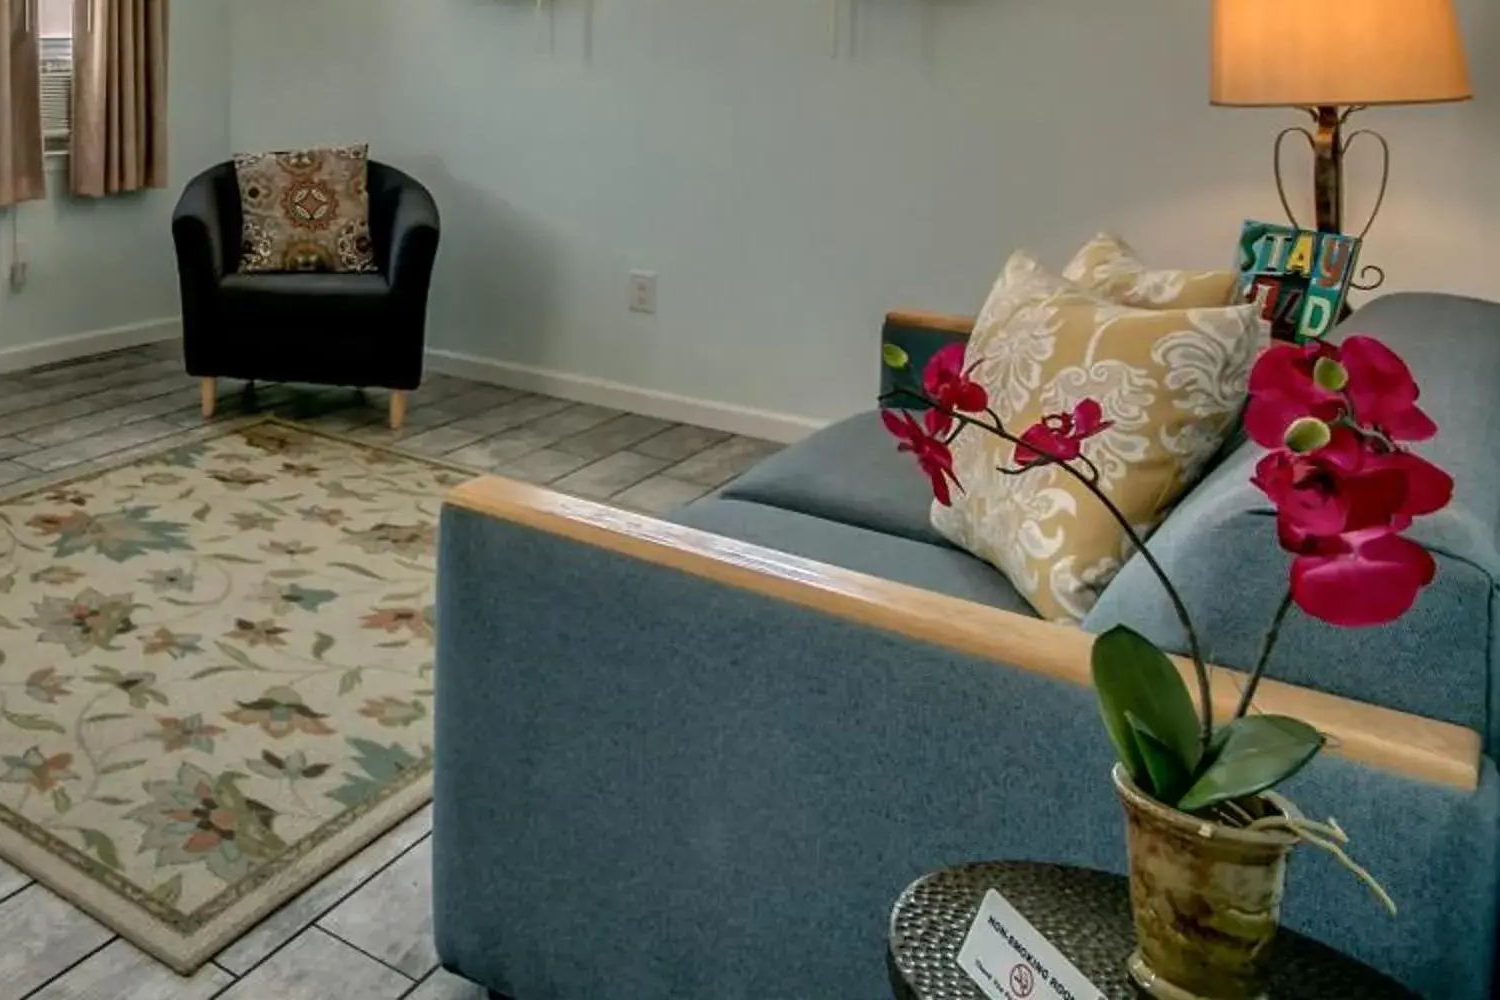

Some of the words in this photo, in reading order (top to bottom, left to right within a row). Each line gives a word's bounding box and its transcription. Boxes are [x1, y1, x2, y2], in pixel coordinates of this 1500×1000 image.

[1240, 222, 1350, 288] STAY
[1244, 283, 1331, 338] ILD
[987, 915, 1049, 980] NON-SMOKING
[1050, 977, 1075, 1000] ROO
